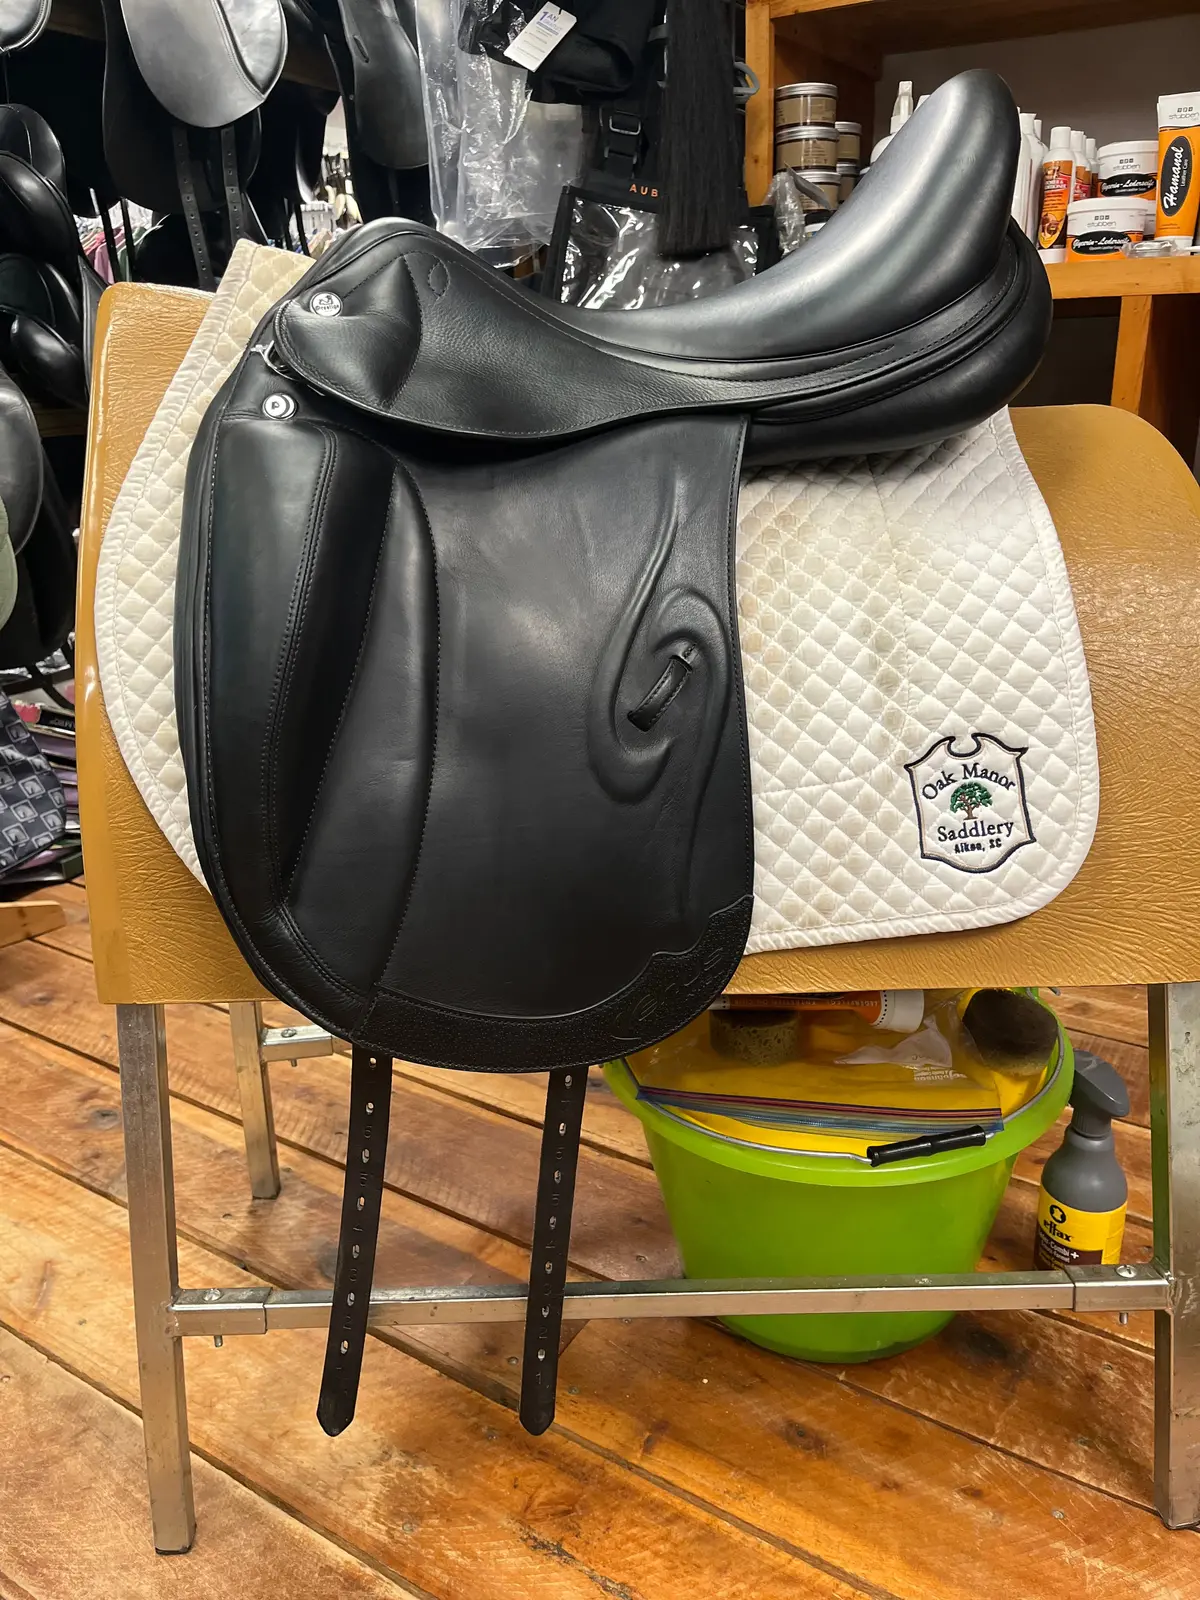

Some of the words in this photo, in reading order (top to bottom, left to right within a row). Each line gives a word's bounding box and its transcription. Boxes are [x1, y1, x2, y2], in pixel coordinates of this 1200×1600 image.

[1163, 146, 1184, 209] Hamanol
[921, 770, 958, 800] Oak
[961, 762, 1016, 791] Manor
[937, 820, 1014, 842] Saddlery
[989, 838, 1002, 849] SC
[1043, 1219, 1072, 1242] effax
